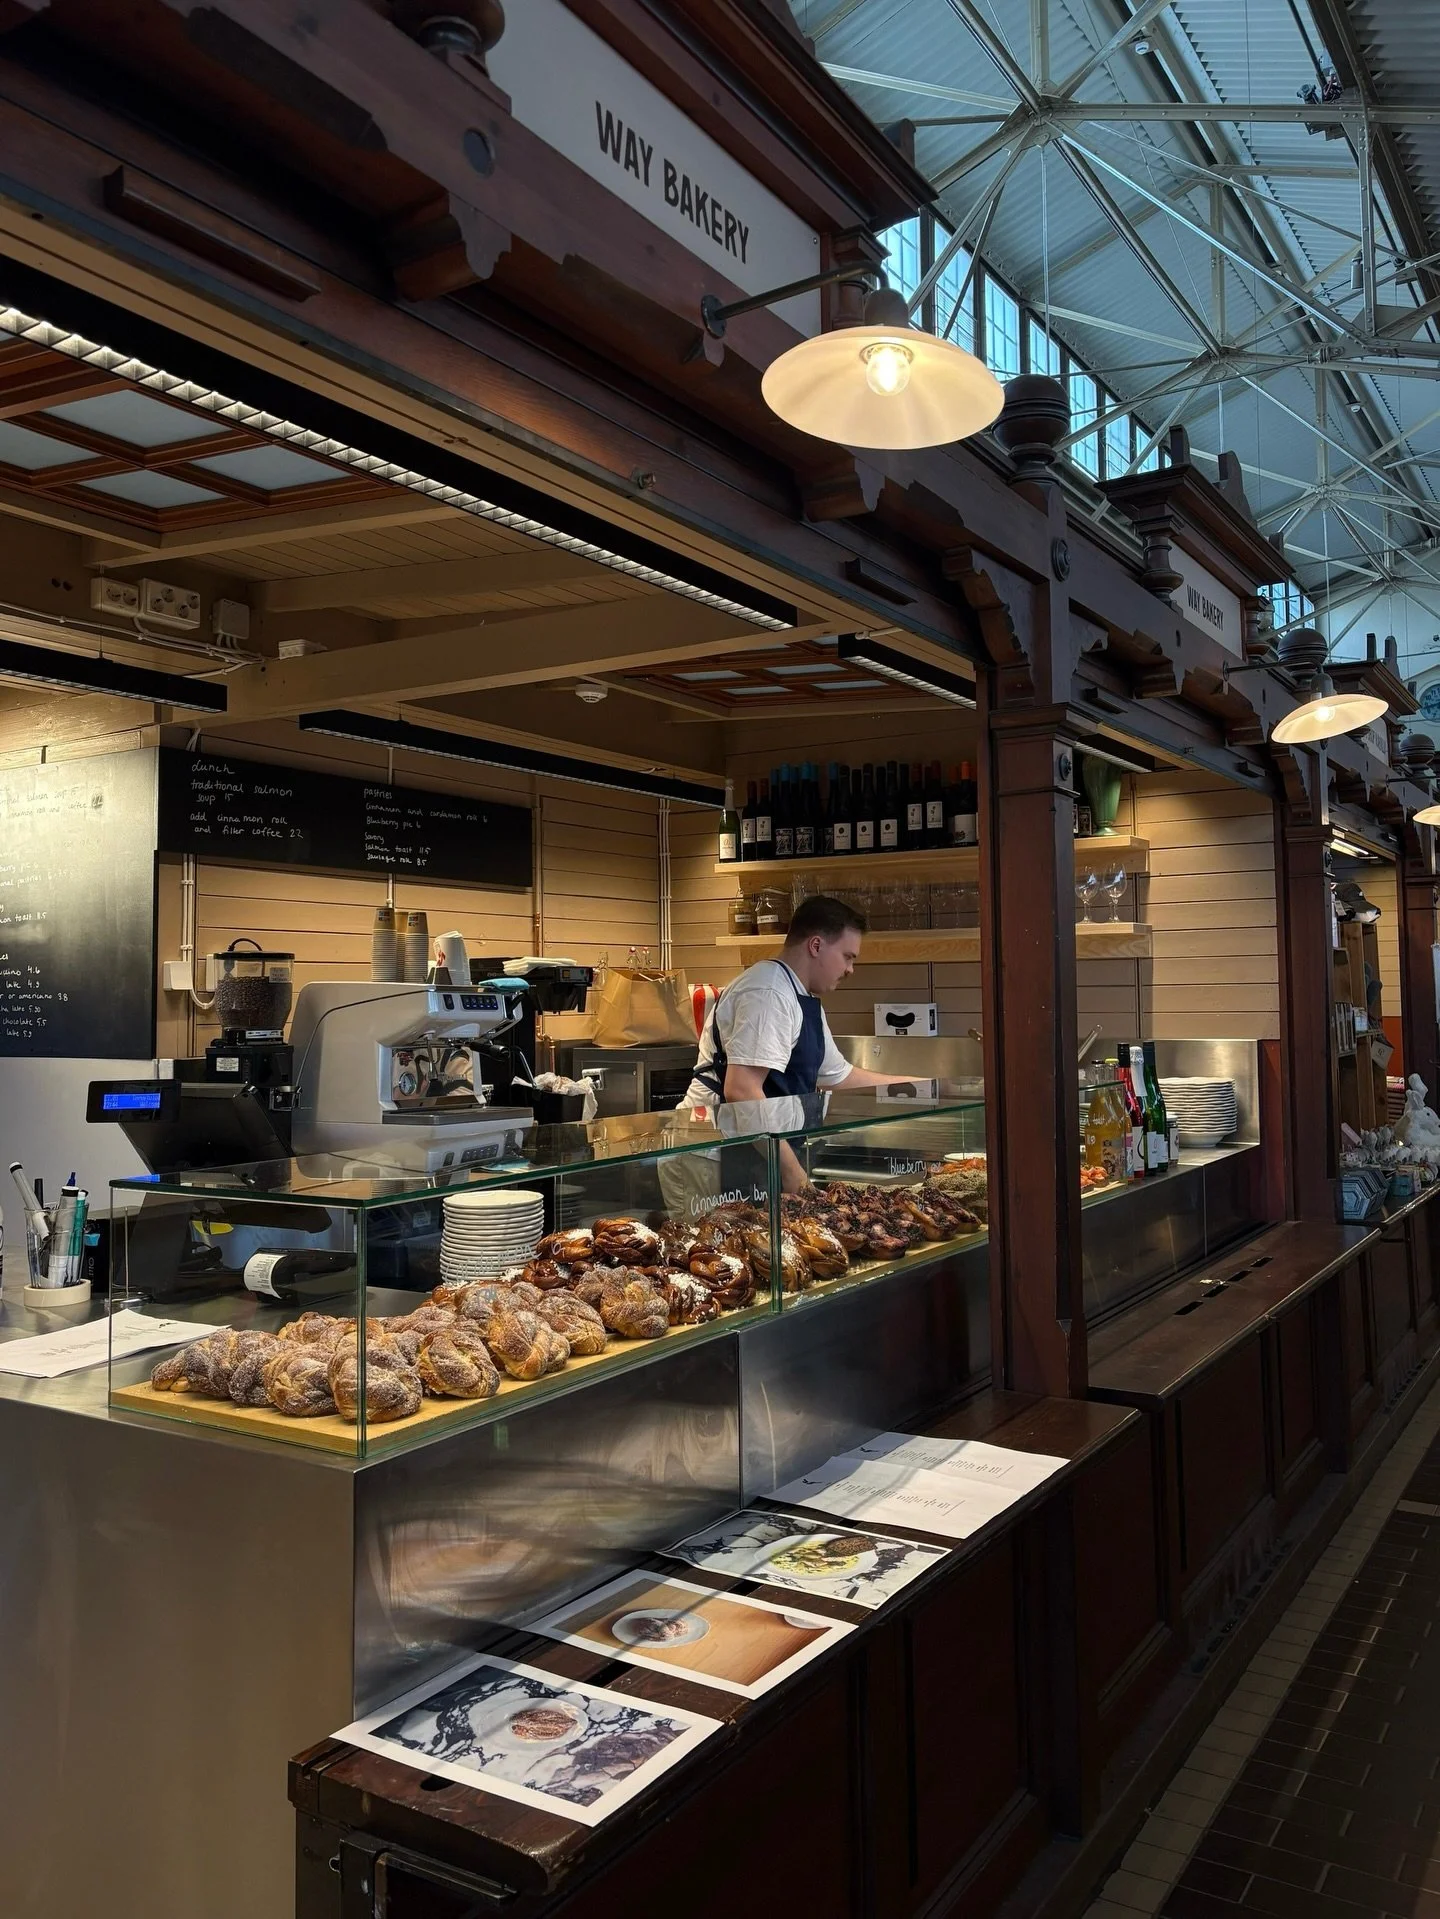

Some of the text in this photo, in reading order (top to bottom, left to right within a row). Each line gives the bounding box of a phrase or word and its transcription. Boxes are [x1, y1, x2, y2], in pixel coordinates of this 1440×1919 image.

[595, 101, 749, 264] WAY BAKERY
[1187, 584, 1224, 631] WAY BAKERY
[190, 779, 293, 797] traditional salmon
[196, 793, 216, 806] soup
[190, 812, 207, 822] add
[194, 825, 211, 834] and
[252, 827, 283, 838] coffee
